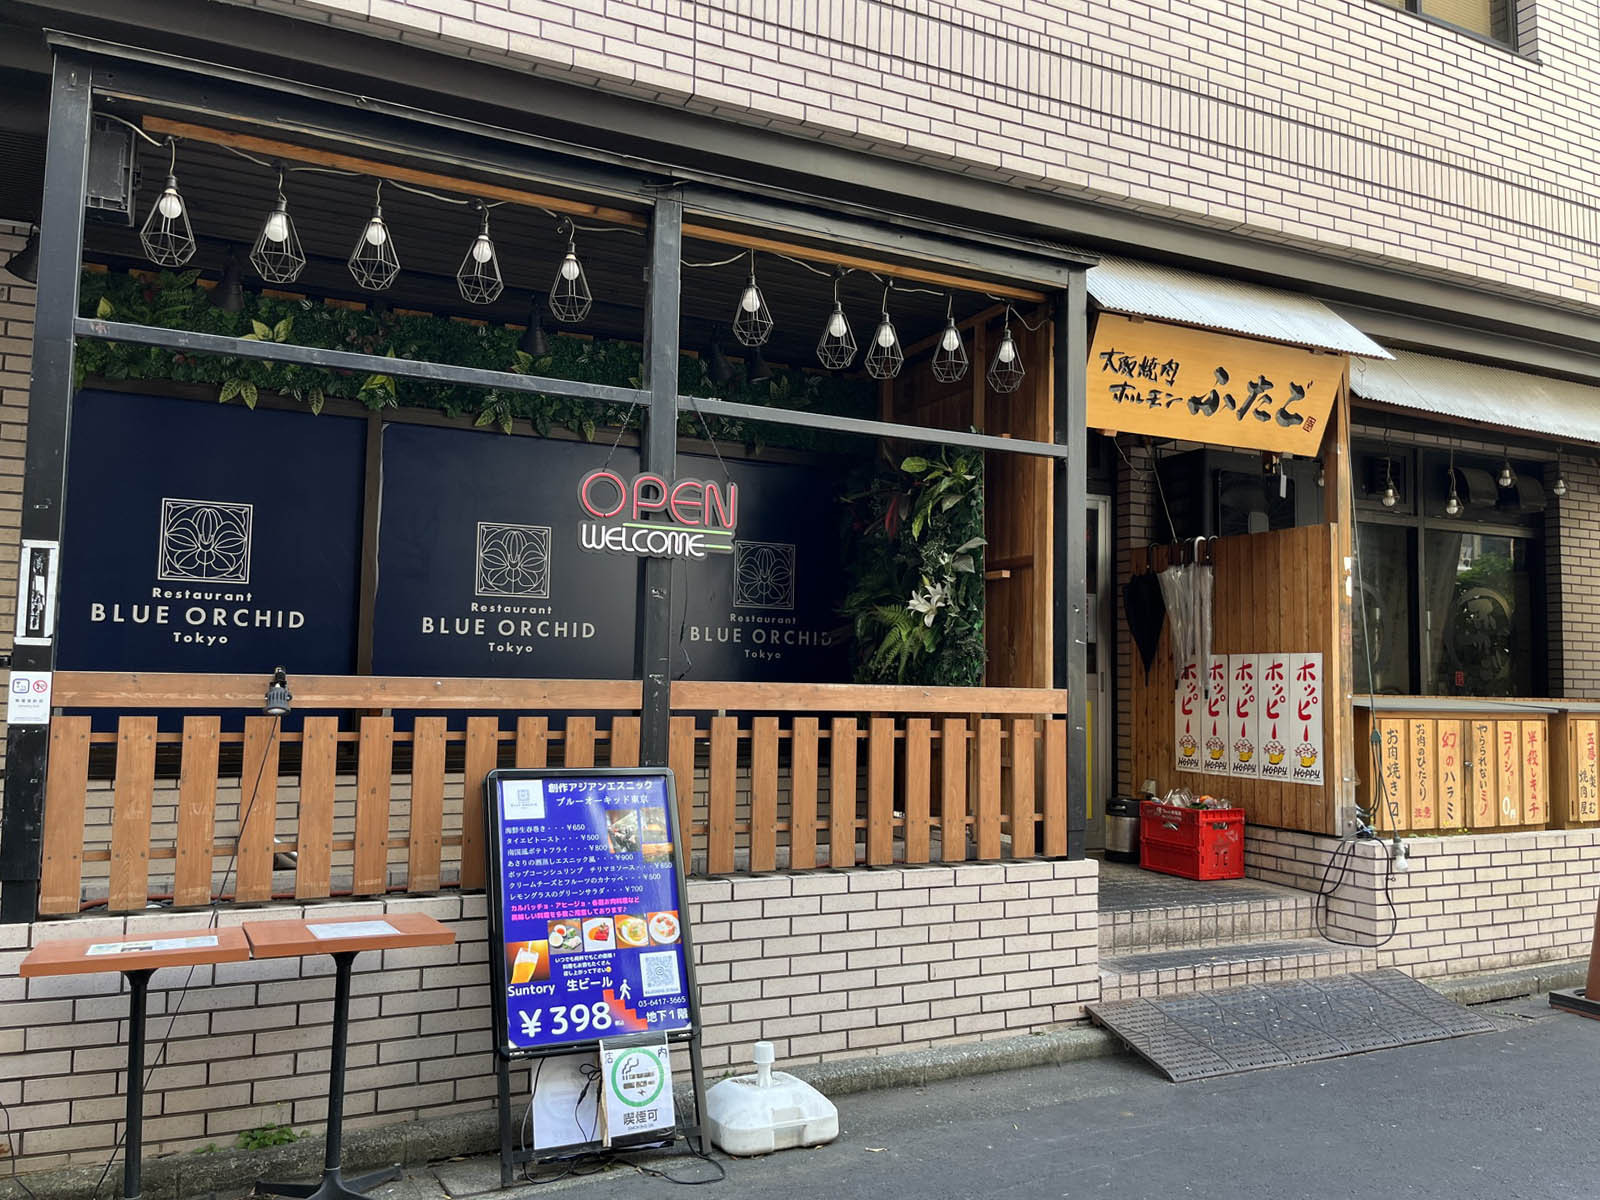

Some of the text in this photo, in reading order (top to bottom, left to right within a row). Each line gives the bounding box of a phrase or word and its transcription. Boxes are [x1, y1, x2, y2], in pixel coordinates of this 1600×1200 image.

[1100, 348, 1180, 387] 大阪焼肉
[1109, 381, 1183, 409] ホルモン
[1187, 366, 1314, 427] ふたご
[582, 472, 735, 529] OPEN
[582, 524, 705, 557] WELCOME
[152, 587, 252, 602] Restaurant
[90, 603, 305, 628] BLUE ORCHID
[471, 602, 552, 615] Restaurant
[422, 617, 596, 638] BLUE ORCHID
[730, 613, 796, 625] Restaurant
[173, 632, 228, 646] Tokyo
[690, 626, 832, 646] BLUE ORCHID
[488, 642, 533, 655] Tokyo
[744, 649, 782, 661] Tokyo
[1235, 657, 1255, 738] ホッピー
[1265, 657, 1287, 740] ホッピー
[1297, 656, 1318, 742] ホッピー
[1441, 731, 1457, 820] 幻のハラミ
[548, 782, 653, 793] 創作アジアンエスニック
[556, 795, 649, 807] ブルーオーキッド東京
[508, 984, 555, 997] Suntory
[567, 976, 613, 992] 生ビール
[646, 1008, 689, 1023] 地下1階
[623, 1108, 658, 1126] 喫煙可
